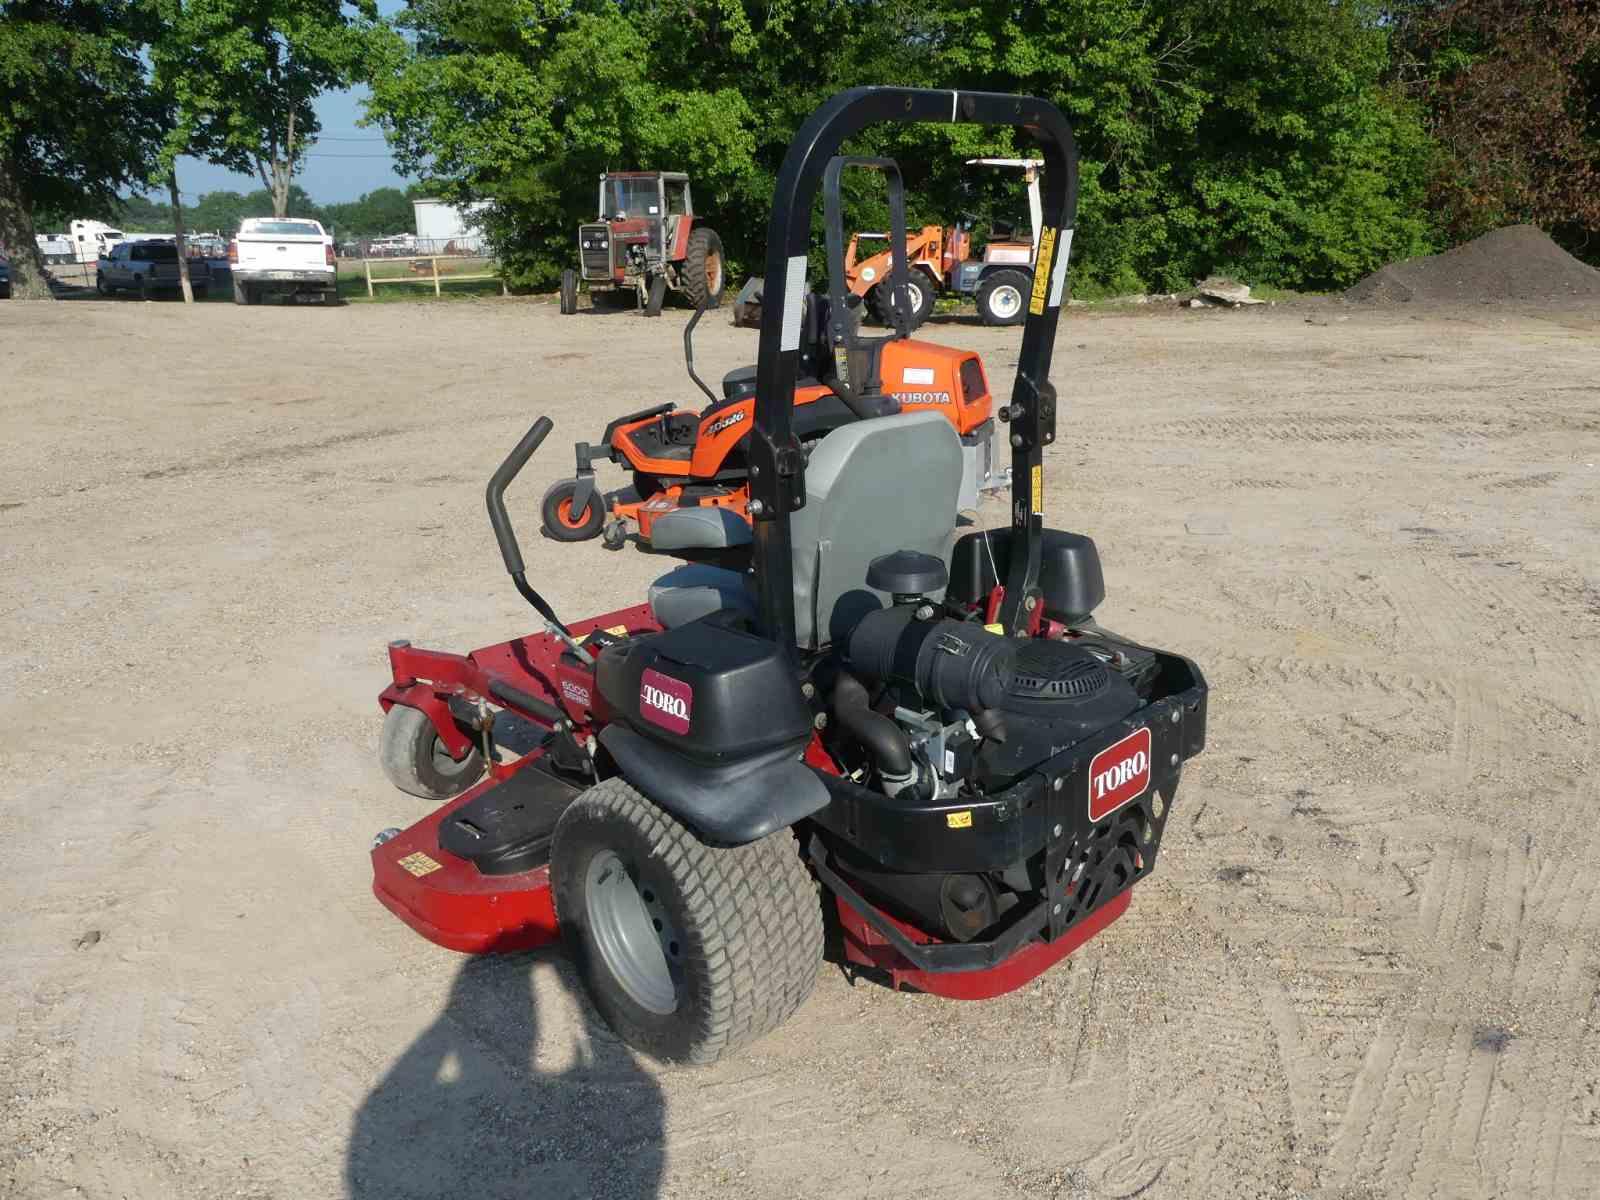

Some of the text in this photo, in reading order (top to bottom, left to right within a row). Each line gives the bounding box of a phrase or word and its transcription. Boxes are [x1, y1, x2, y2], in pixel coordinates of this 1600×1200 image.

[892, 391, 951, 405] KUBOTA
[642, 684, 689, 720] TORO
[1094, 751, 1146, 800] TORO
